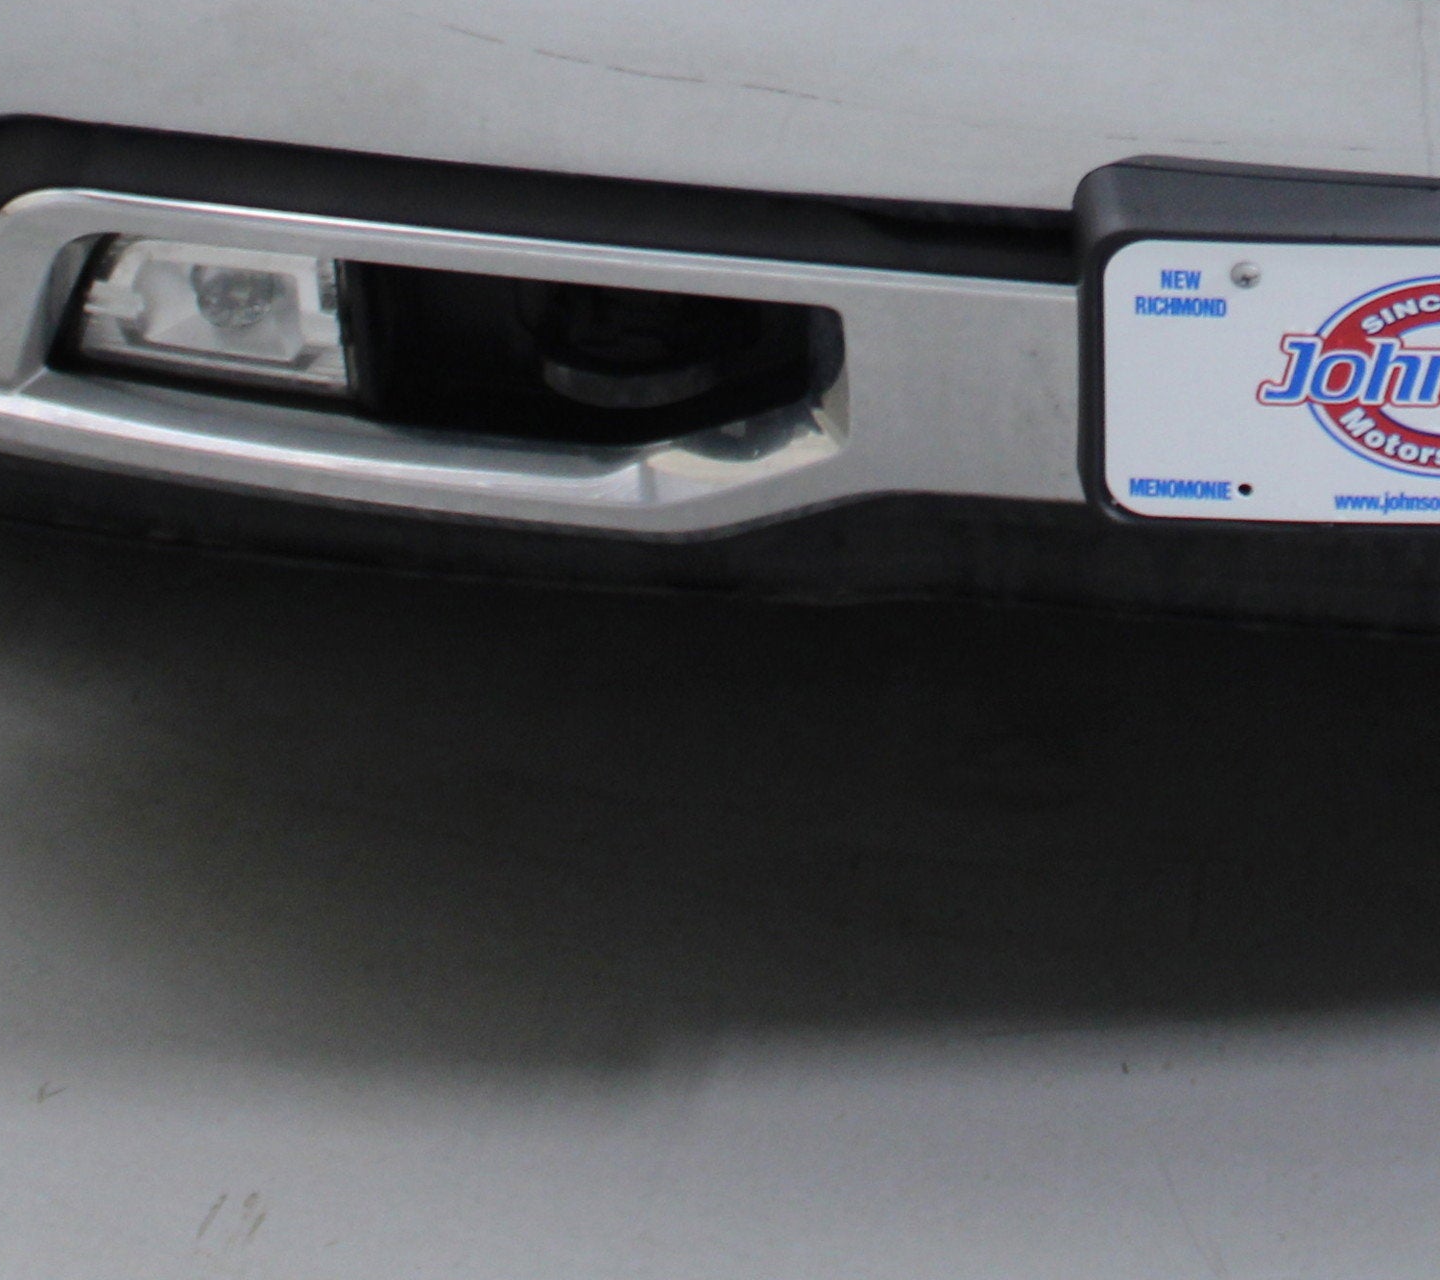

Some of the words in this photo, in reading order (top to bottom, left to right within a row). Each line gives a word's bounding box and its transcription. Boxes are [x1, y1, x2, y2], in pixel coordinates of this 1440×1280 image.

[1160, 269, 1202, 290] NEW
[1134, 295, 1227, 317] RICHMOND
[1129, 478, 1232, 500] MENOMONIE
